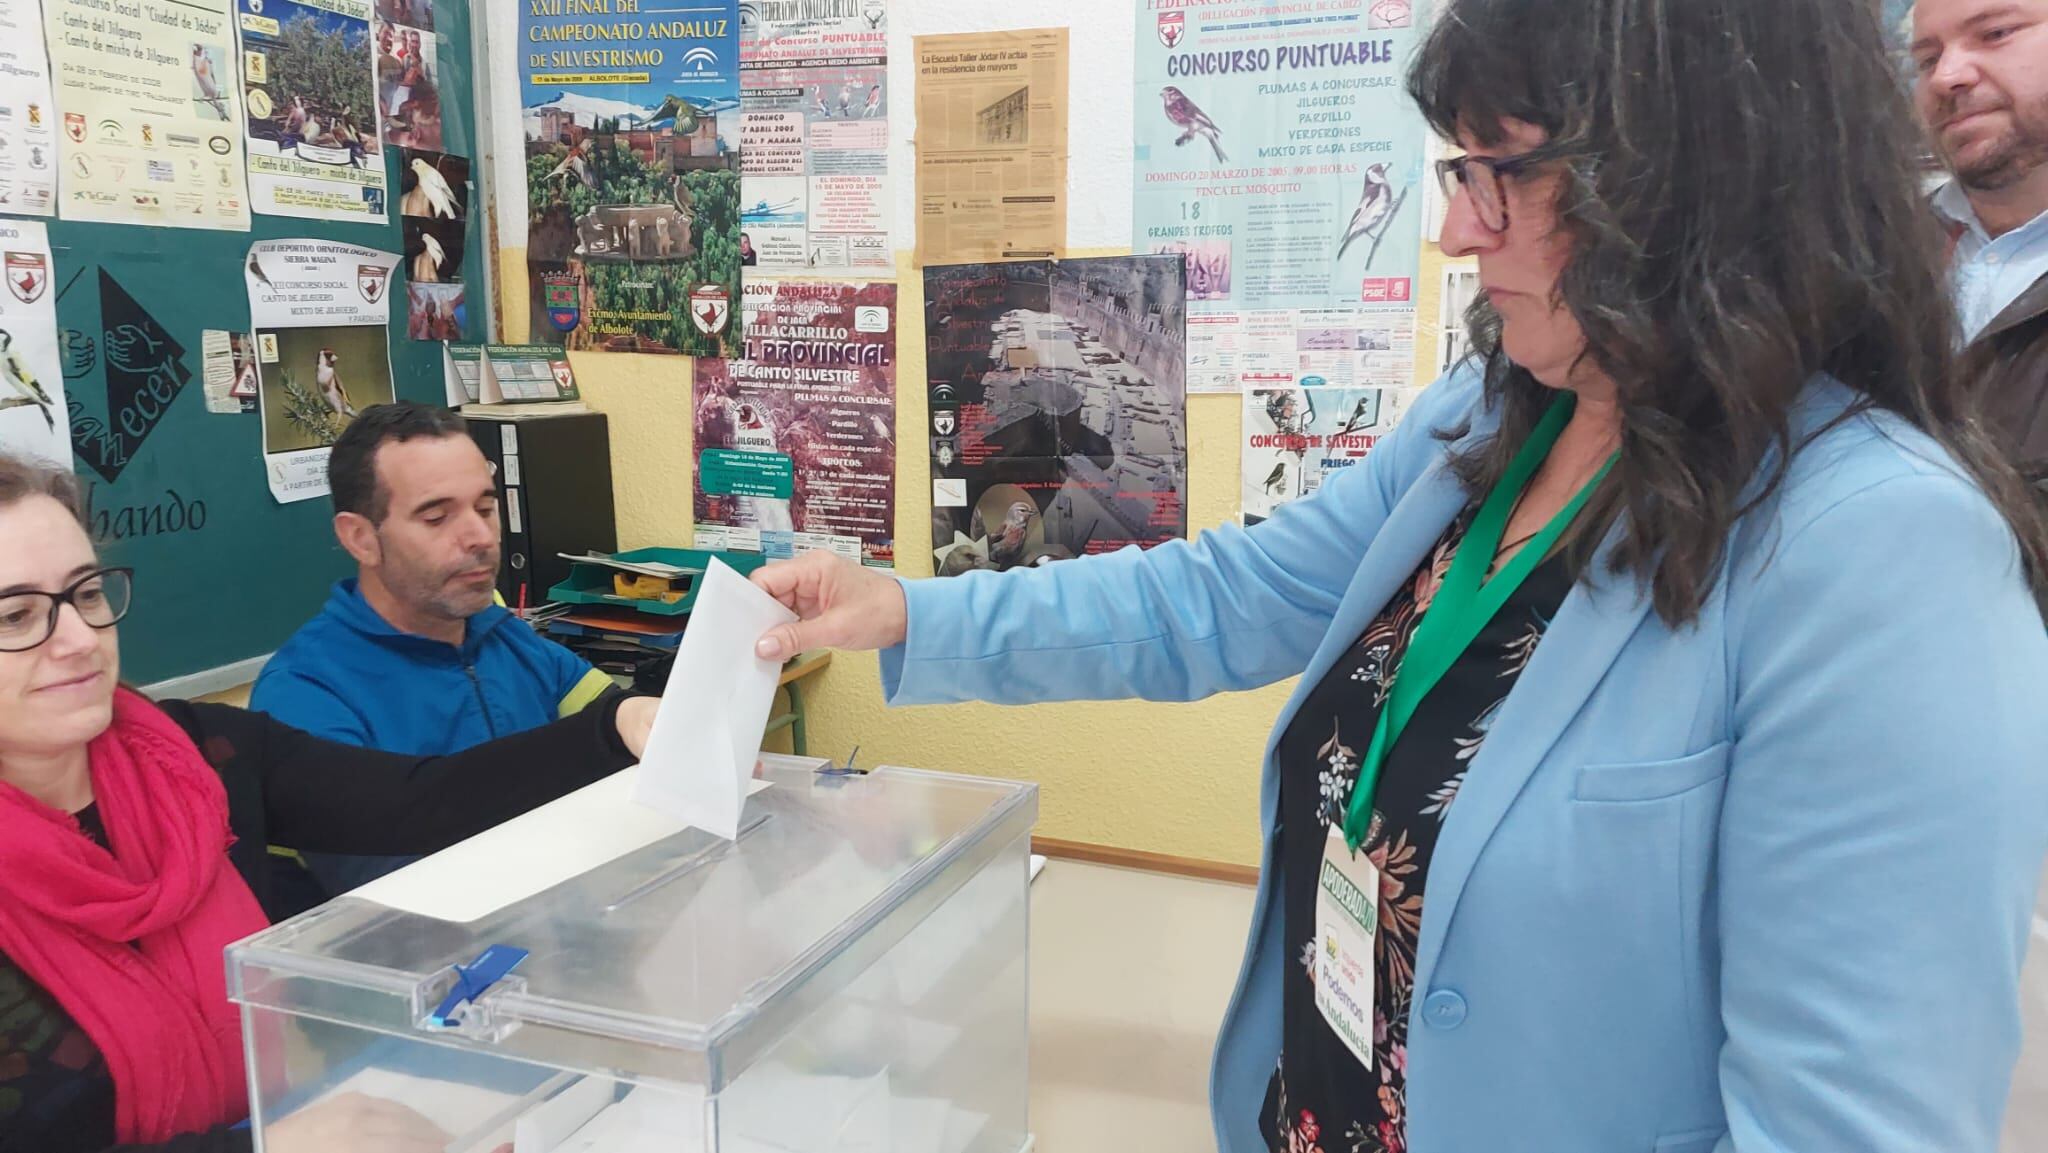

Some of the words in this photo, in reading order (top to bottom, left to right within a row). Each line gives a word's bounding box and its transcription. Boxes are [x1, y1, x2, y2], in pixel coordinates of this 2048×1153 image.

[530, 0, 561, 16] XXII
[566, 0, 611, 15] FINAL
[616, 0, 640, 14] DEL
[63, 12, 89, 30] Canto
[92, 18, 105, 33] del
[108, 20, 142, 40] Jilguero
[181, 12, 191, 29] de
[529, 22, 643, 42] CAMPEONATO
[647, 19, 728, 40] ANDALUZ
[822, 32, 885, 44] PUNTUABLE
[65, 31, 90, 49] Canto
[93, 36, 104, 52] de
[134, 46, 144, 59] de
[146, 48, 180, 67] Jilguero
[529, 53, 548, 68] DE
[552, 48, 664, 68] SILVESTRISMO
[922, 55, 931, 64] La
[931, 54, 958, 64] Escuela
[960, 53, 977, 62] Taller
[1167, 48, 1270, 78] CONCURSO
[1276, 39, 1393, 71] PUNTUABLE
[922, 66, 931, 75] en
[932, 65, 939, 74] la
[939, 64, 976, 74] residencia
[977, 63, 986, 72] de
[987, 62, 1018, 73] mayores
[1258, 81, 1307, 95] PLUMAS
[1310, 81, 1319, 92] A
[1296, 94, 1356, 108] JILGUEROS
[1299, 111, 1351, 124] PARDILLO
[1288, 126, 1361, 141] VERDERONES
[1258, 145, 1296, 158] MIXTO
[1299, 144, 1313, 156] DE
[1315, 143, 1345, 155] CADA
[1350, 141, 1392, 154] ESPECIE
[1145, 171, 1196, 183] DOMINGO
[1211, 169, 1249, 181] MARZO
[1251, 168, 1264, 179] DE
[1320, 163, 1358, 175] HORAS
[1196, 185, 1228, 198] FINCA
[1230, 185, 1244, 196] EL
[1247, 183, 1302, 197] MOSQUITO
[1148, 225, 1190, 238] GRANDES
[1194, 224, 1233, 237] TROFEOS
[776, 285, 838, 298] ANDALUZA
[617, 308, 672, 321] Ayuntamiento
[588, 325, 598, 334] de
[600, 323, 634, 336] Albolote
[762, 339, 890, 367] PROVINCIAL
[728, 364, 746, 378] DE
[747, 365, 792, 380] CANTO
[793, 368, 860, 384] SILVESTRE
[737, 436, 771, 446] JILGUERO
[1323, 965, 1364, 1025] Podemos
